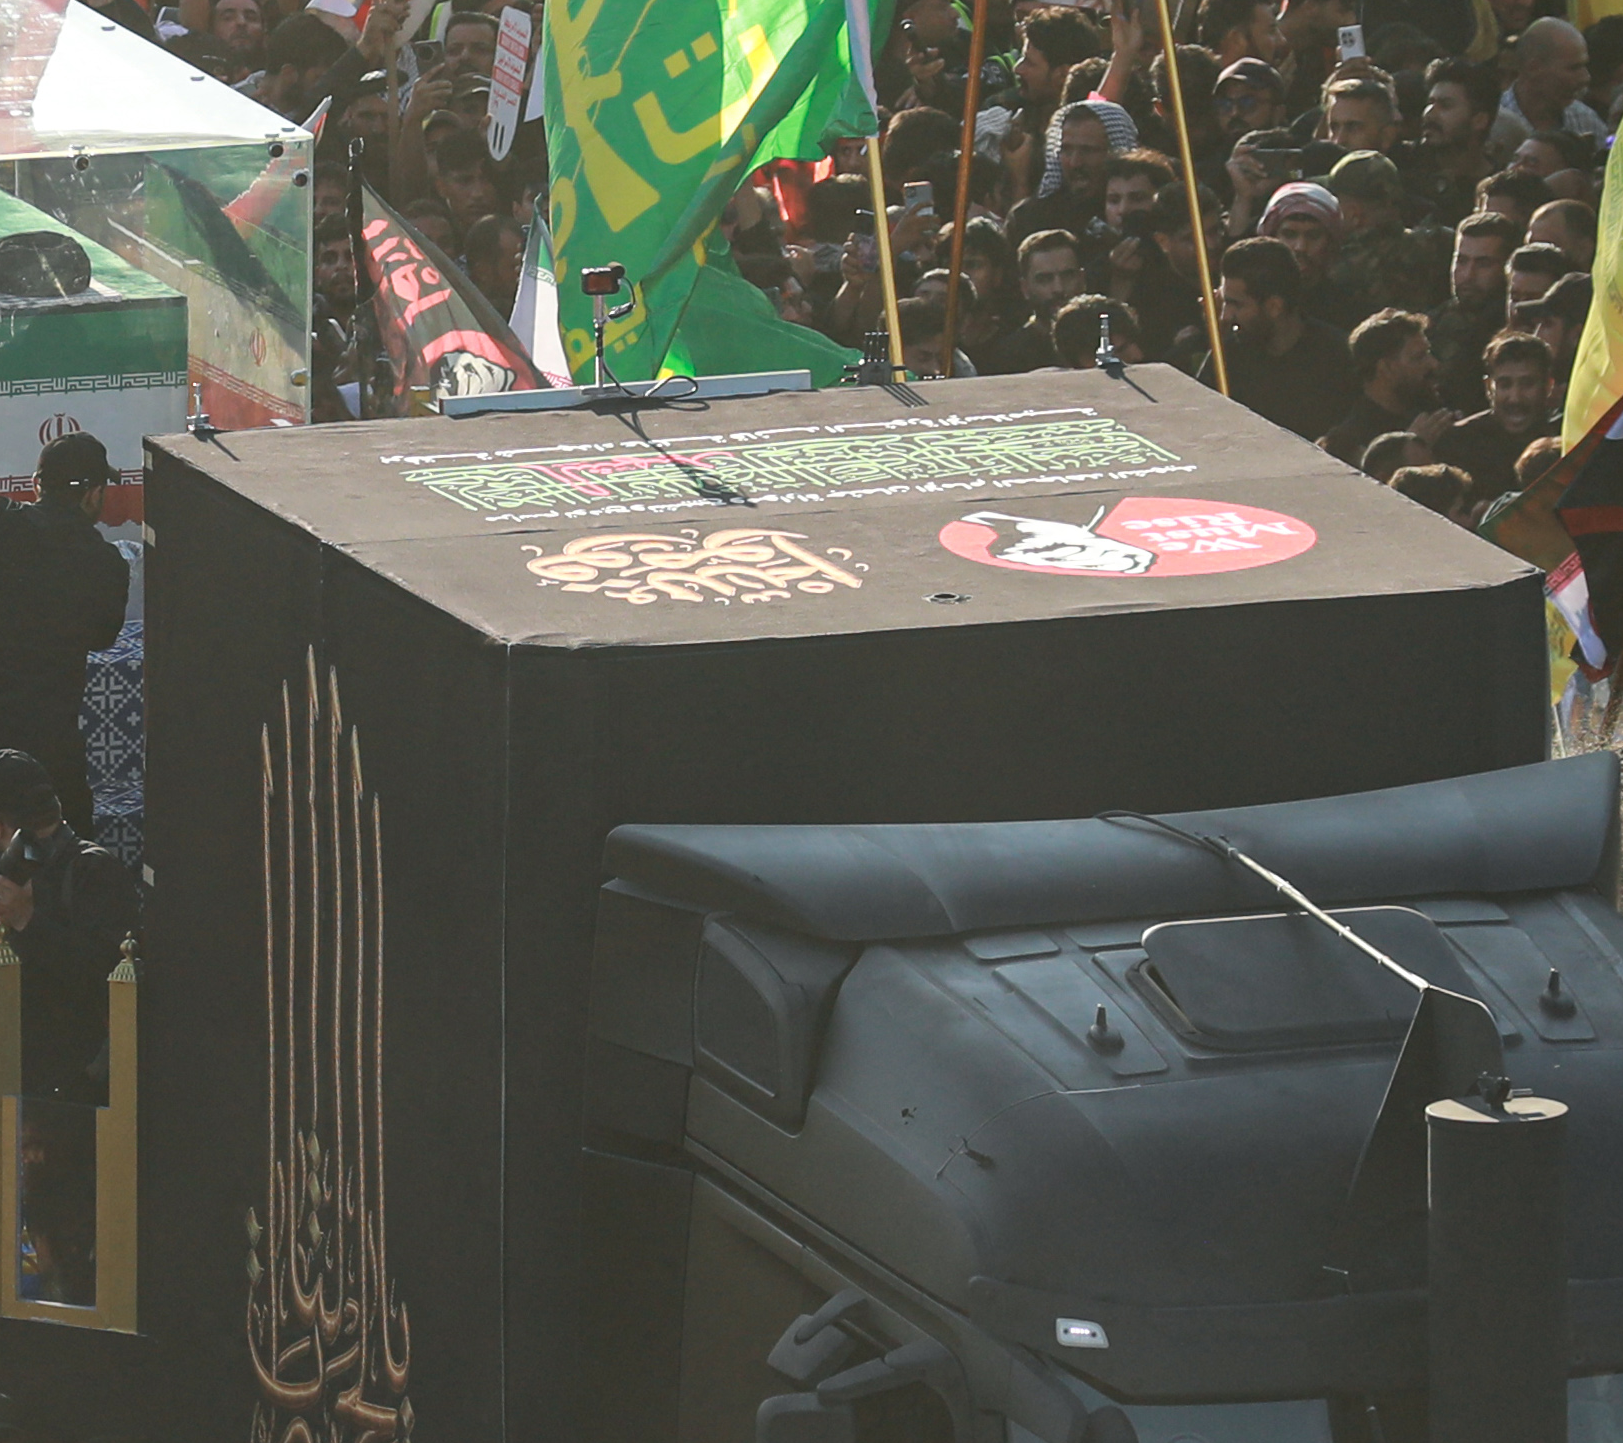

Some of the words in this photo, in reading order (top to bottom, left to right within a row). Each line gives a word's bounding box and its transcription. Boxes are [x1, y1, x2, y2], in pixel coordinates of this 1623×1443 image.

[1121, 512, 1252, 530] Rise
[1140, 521, 1300, 542] Must
[1157, 537, 1263, 554] We
